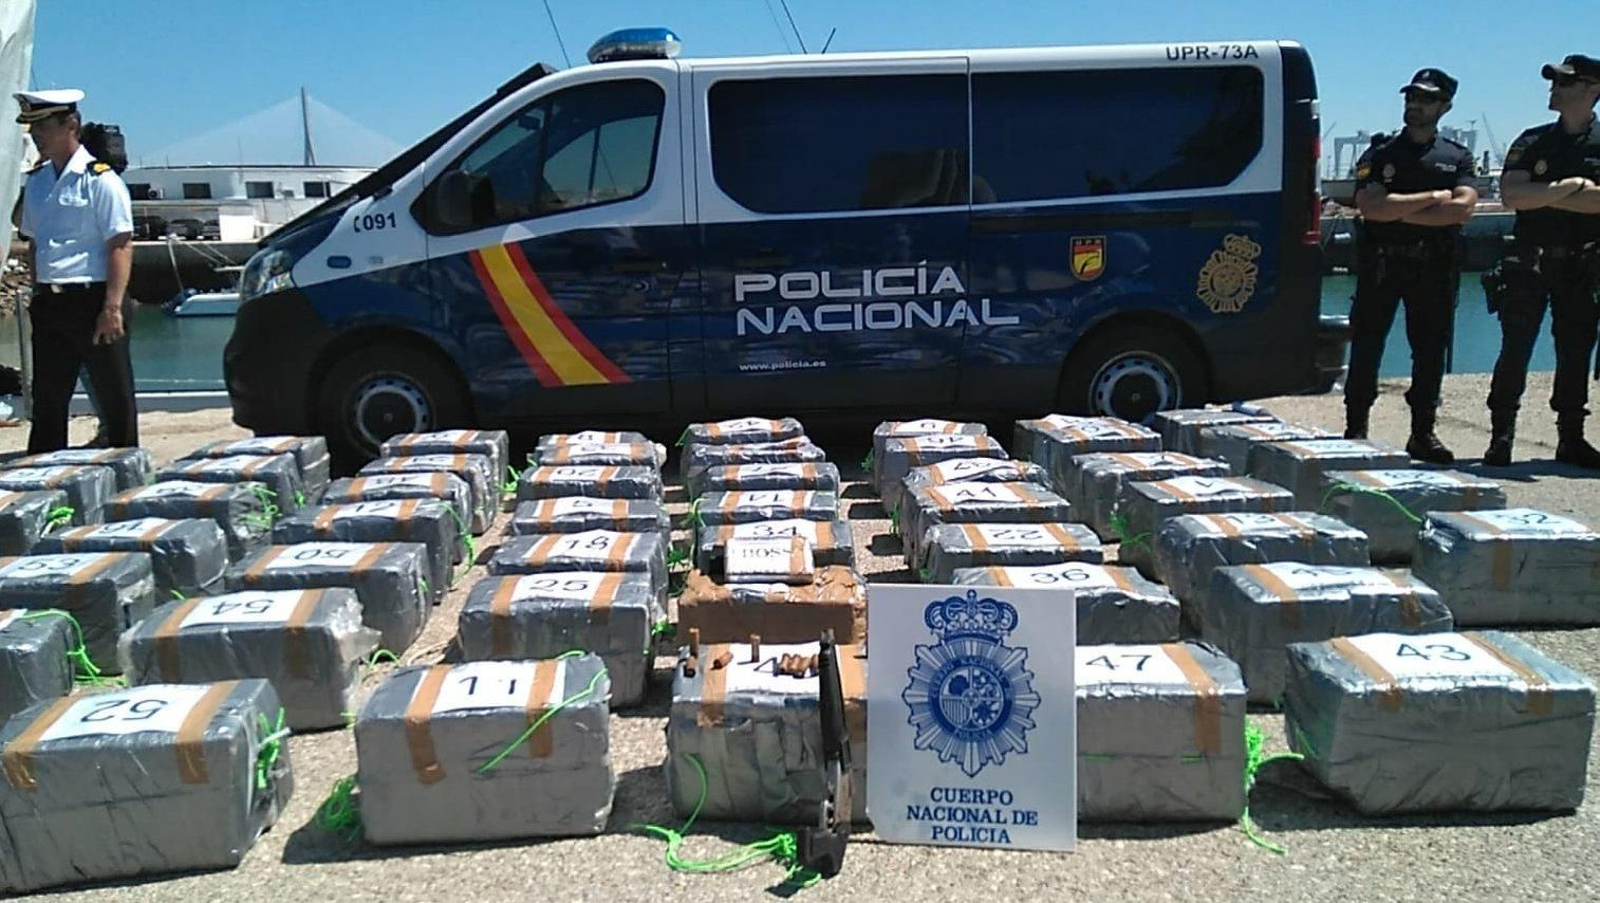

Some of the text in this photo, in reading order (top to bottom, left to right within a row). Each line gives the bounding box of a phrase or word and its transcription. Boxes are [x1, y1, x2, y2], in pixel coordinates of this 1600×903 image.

[1166, 45, 1259, 60] UPR-73A
[362, 211, 397, 231] 091
[735, 259, 965, 302] POLICÍA
[737, 298, 1020, 336] NACIONAL
[739, 360, 827, 371] www.policia.es
[1030, 568, 1090, 584] 36
[529, 579, 588, 593] 25
[212, 599, 275, 616] 54
[1396, 642, 1471, 663] 43
[1085, 654, 1153, 672] 47
[81, 698, 168, 723] 52
[930, 786, 1014, 806] CUERPO
[906, 804, 1038, 826] NACIONAL DE
[931, 825, 1011, 844] POLICIA
